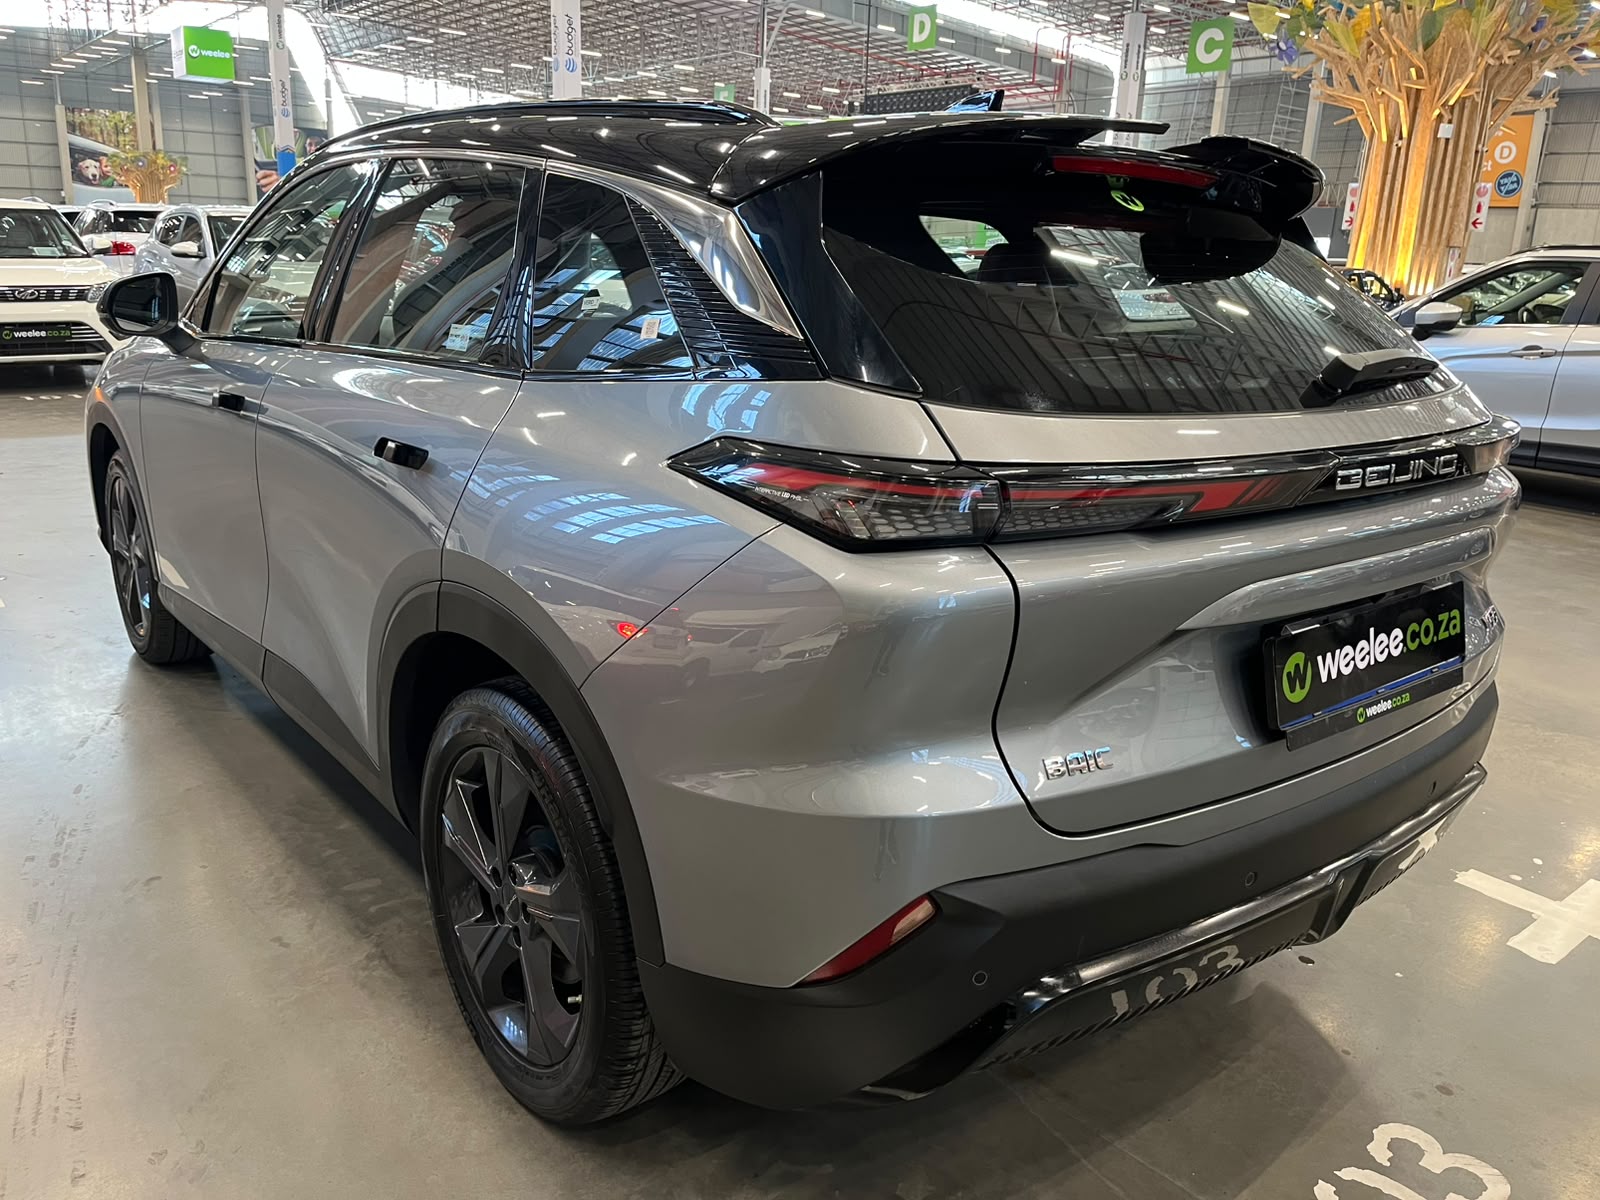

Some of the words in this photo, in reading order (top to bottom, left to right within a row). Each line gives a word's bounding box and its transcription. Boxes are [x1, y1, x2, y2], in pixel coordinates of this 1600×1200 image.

[564, 13, 576, 56] budget
[913, 13, 932, 43] D
[200, 49, 231, 58] weelee
[1196, 28, 1225, 64] C
[1336, 453, 1458, 491] BEIJING
[1041, 746, 1113, 781] BAIC
